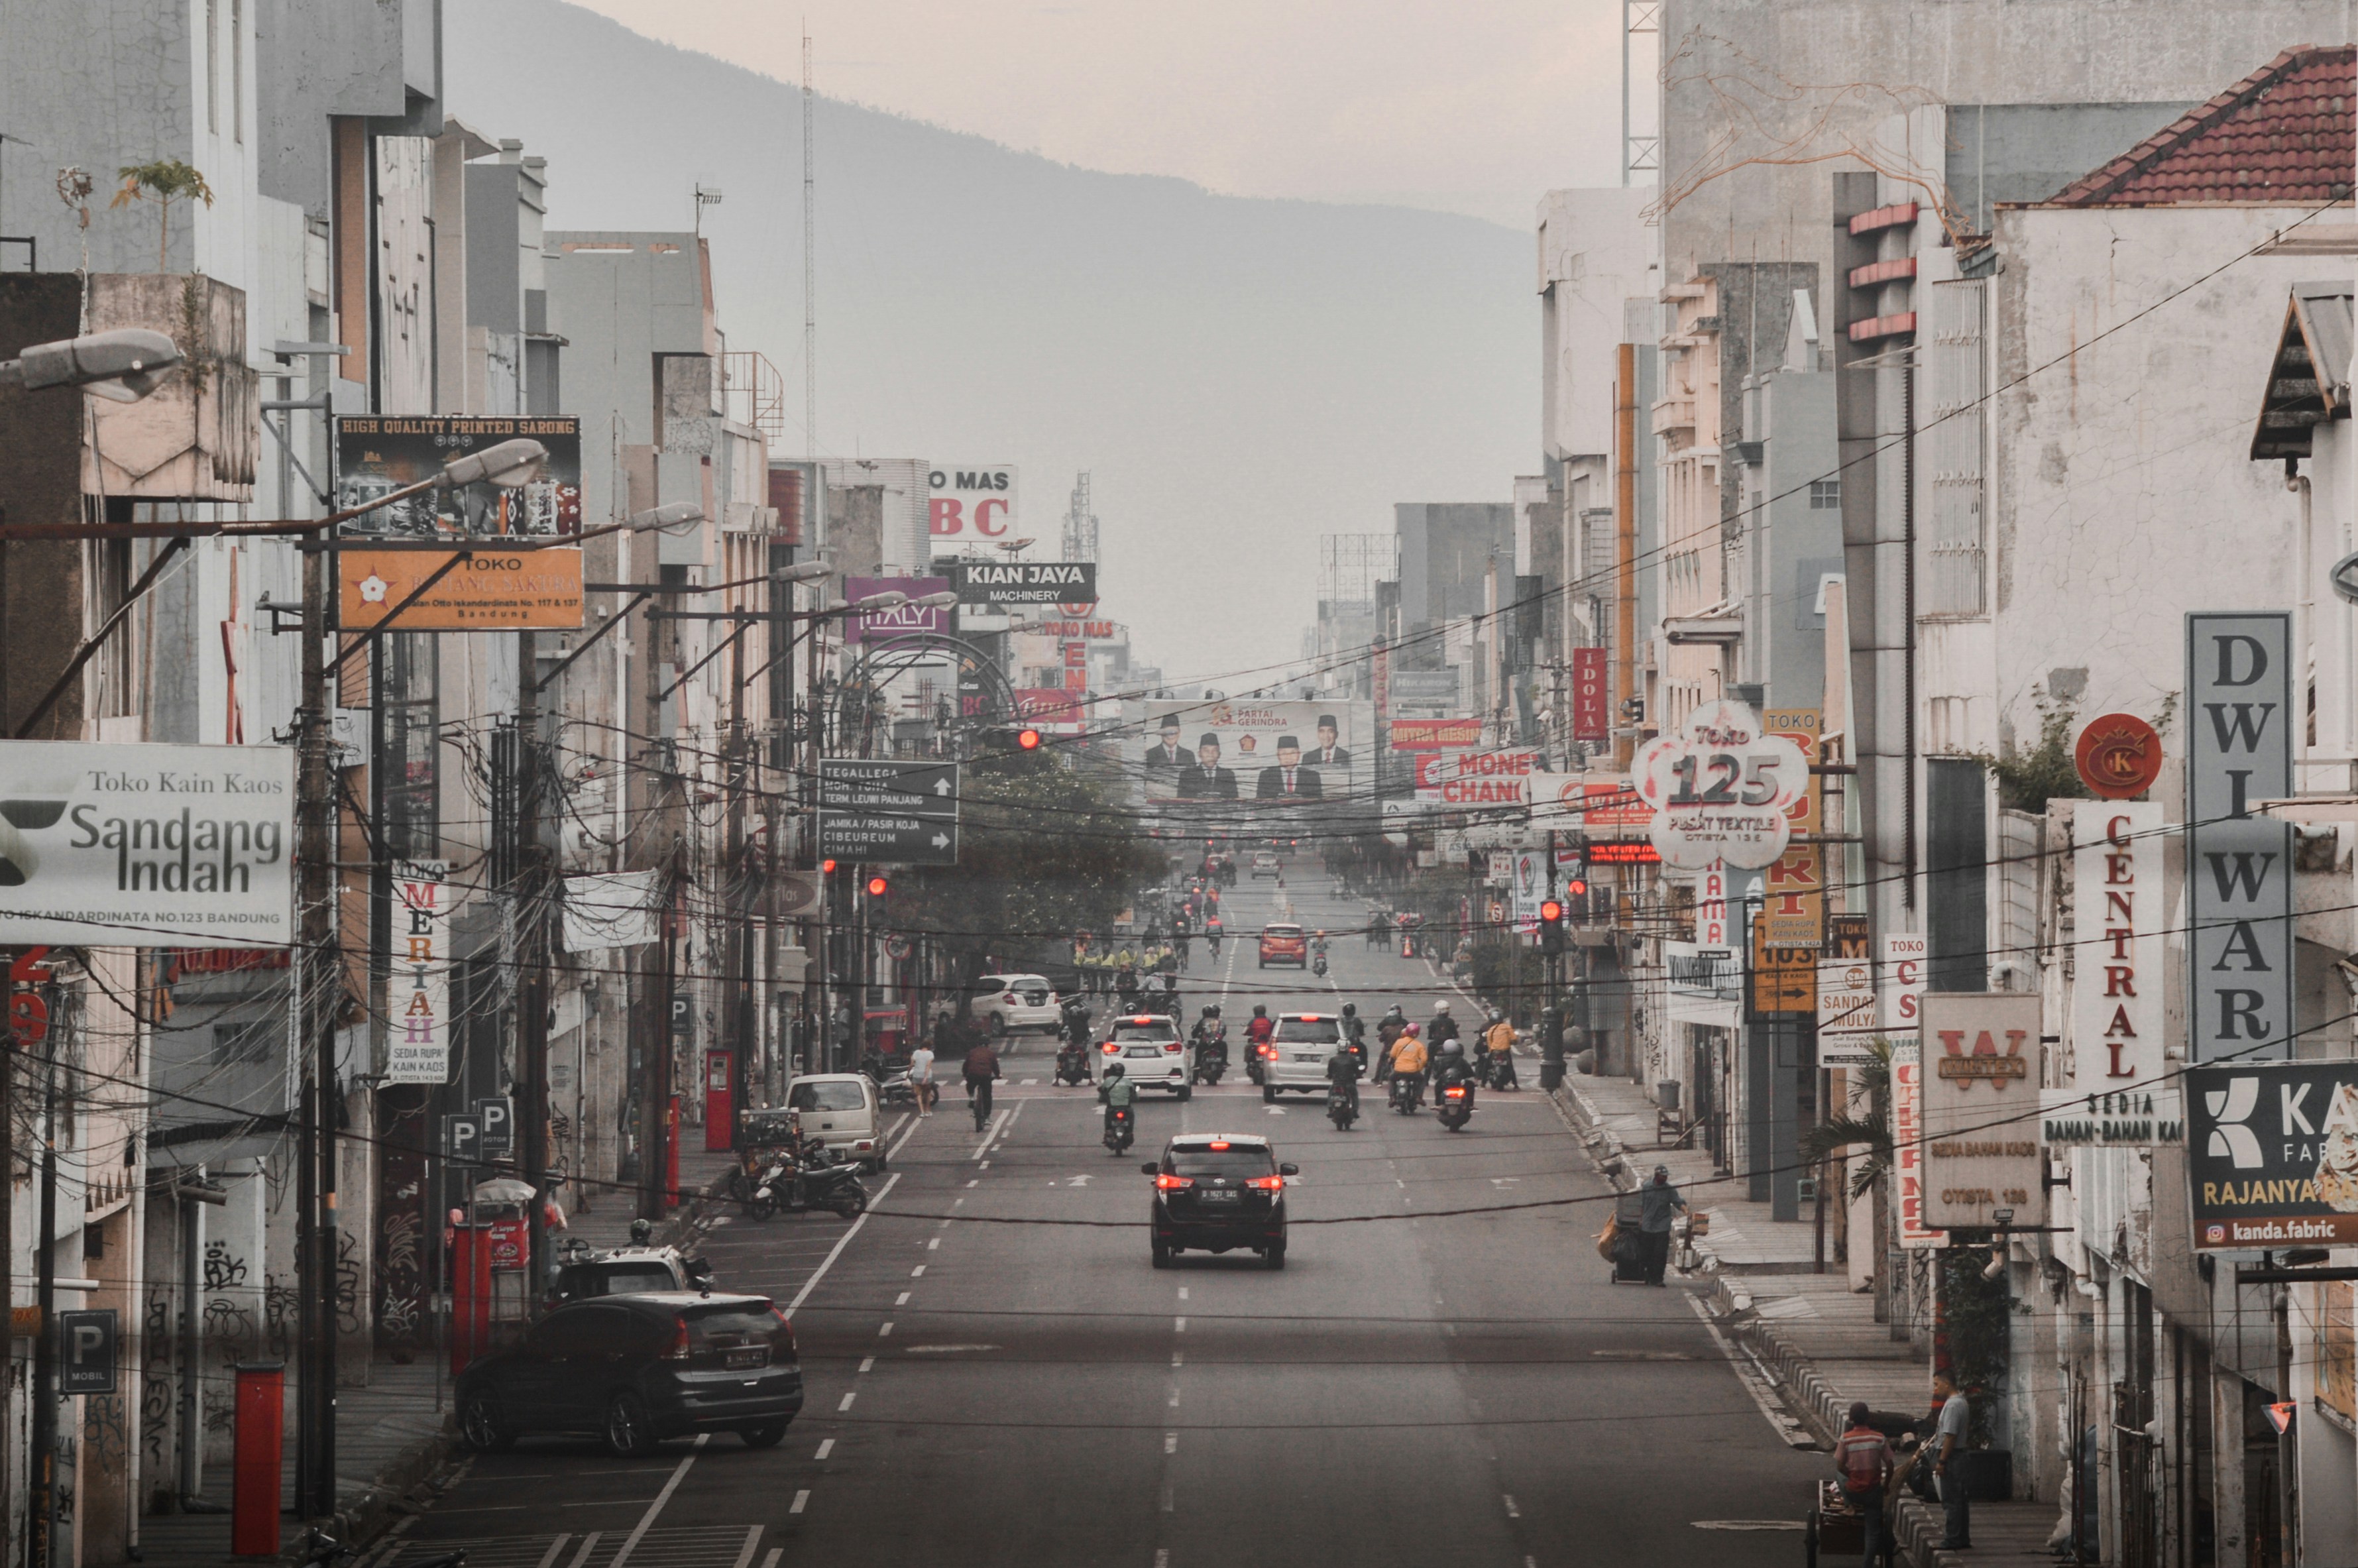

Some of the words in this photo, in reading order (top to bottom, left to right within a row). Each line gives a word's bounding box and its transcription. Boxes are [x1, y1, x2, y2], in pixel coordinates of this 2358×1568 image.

[343, 420, 378, 433] HIGH
[384, 420, 445, 434] QUALITY
[451, 420, 514, 434] PRINTED
[518, 420, 575, 434] SARONG
[956, 471, 1009, 490] MAS
[465, 559, 522, 571] TOKO
[967, 566, 1023, 584] KIAN
[1028, 566, 1086, 584] JAYA
[432, 598, 453, 607] Otto
[989, 590, 1061, 601] MACHINERY
[458, 610, 528, 619] Bandung
[1045, 621, 1080, 638] TOKO
[1083, 621, 1113, 638] MAS
[1583, 652, 1597, 728] IDOLA
[1768, 714, 1815, 728] TOKO
[1392, 728, 1435, 742] MITRA
[825, 767, 899, 779] TEGALLEGA
[87, 770, 150, 793] Toko
[158, 771, 215, 793] Kain
[223, 773, 283, 795] Kaos
[1667, 754, 1781, 807] 125
[824, 793, 850, 804] TERM.
[852, 794, 879, 805] LEUWI
[880, 795, 923, 805] PANJANG
[824, 818, 859, 828] JAMIKA
[868, 820, 894, 829] PASIR
[896, 820, 920, 830] KOJA
[1668, 816, 1714, 831] PUSAT
[70, 803, 281, 864] Sandang
[823, 832, 896, 843] CIBEUREUM
[823, 845, 867, 855] CIMAHI
[117, 852, 250, 893] Indah
[155, 912, 203, 923] NO.123
[207, 913, 280, 924] BANDUNG
[1771, 920, 1794, 928] SEDIA
[1840, 924, 1869, 935] TOKO
[1891, 940, 1925, 952] TOKO
[2104, 814, 2137, 1078] CENTRAL
[402, 883, 439, 1044] MERIAH
[394, 1048, 419, 1058] SEDIA
[393, 1062, 416, 1072] KAIN
[418, 1062, 445, 1072] KAOS
[1946, 1060, 2020, 1075] WINTEX
[2088, 1093, 2154, 1115] SEDIA
[2045, 1120, 2152, 1142] BAHAN-BAHAN
[1931, 1141, 1964, 1157] SEDIA
[1965, 1141, 2003, 1158] BAHAN
[2005, 1141, 2036, 1157] KAOS
[1942, 1189, 1995, 1205] OTISTA
[2204, 1178, 2317, 1205] RAJANYA
[2233, 1219, 2335, 1241] kanda.fabric
[74, 1325, 104, 1365] P
[72, 1372, 106, 1381] MOBIL
